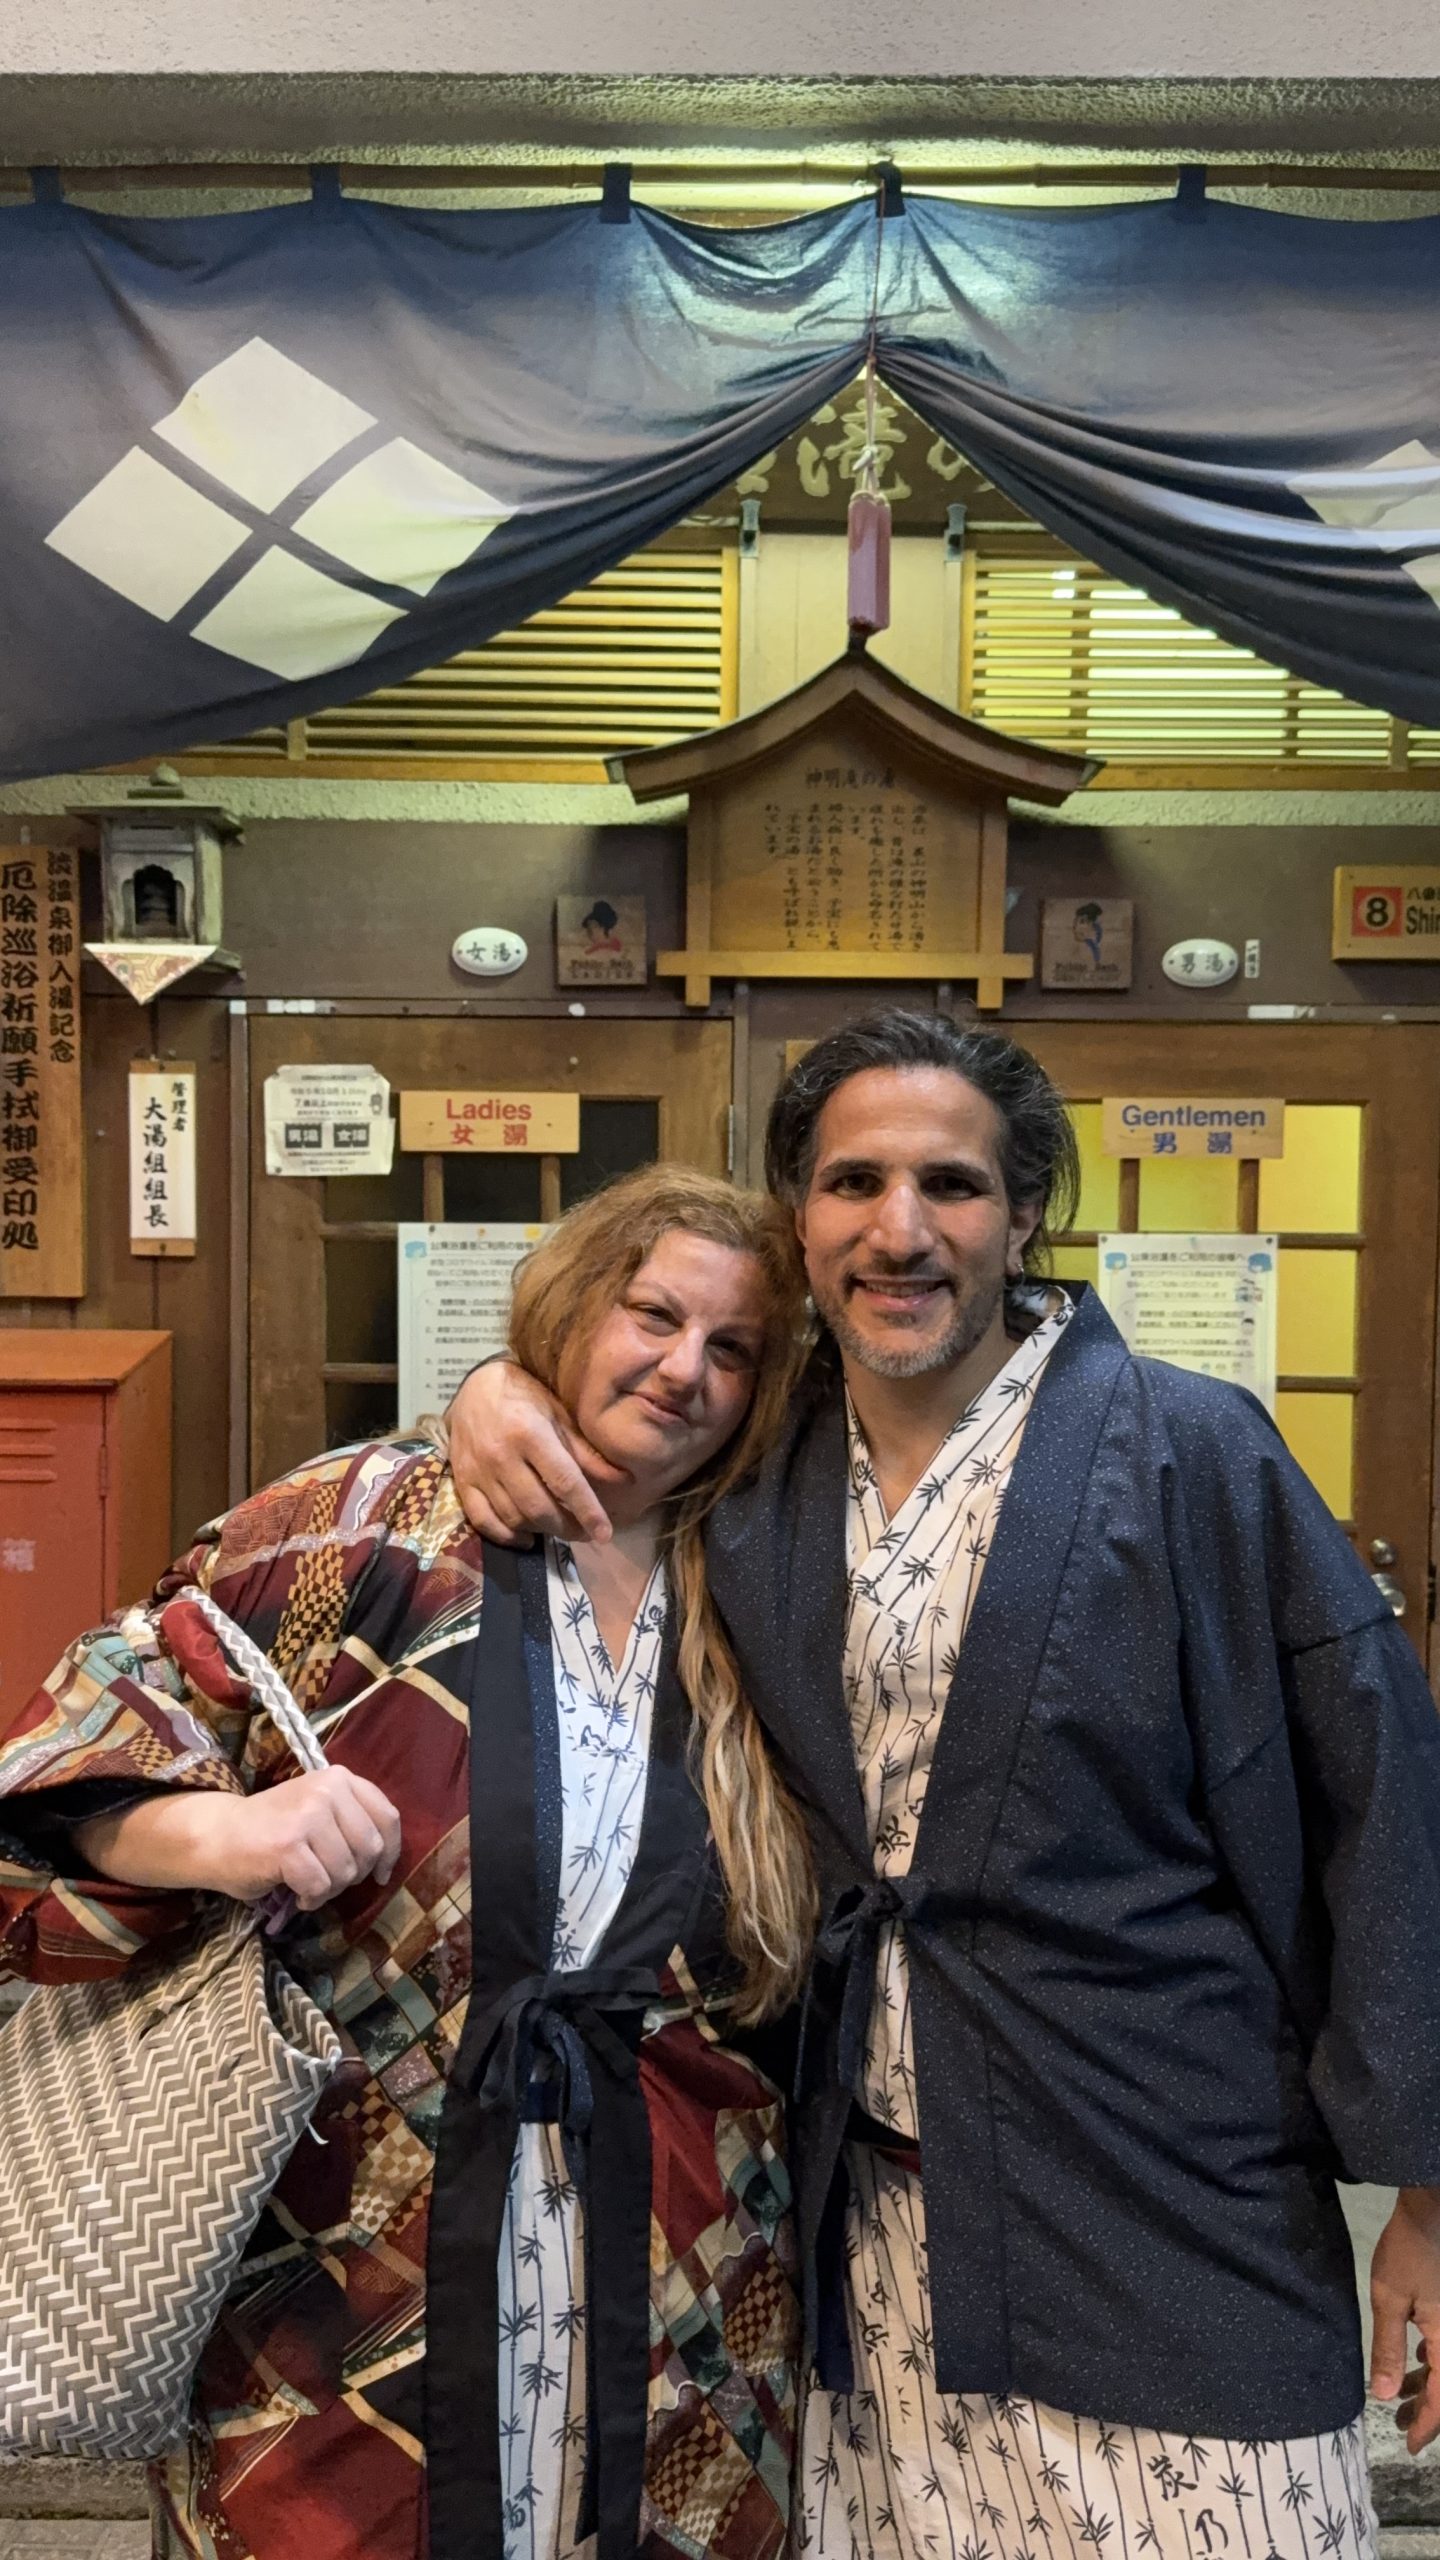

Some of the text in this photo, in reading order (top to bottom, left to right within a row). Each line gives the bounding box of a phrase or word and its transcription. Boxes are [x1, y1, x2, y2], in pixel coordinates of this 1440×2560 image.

[1366, 896, 1389, 927] 8
[466, 942, 512, 962] 女湯
[1181, 952, 1225, 974] 男湯
[1, 861, 40, 1251] 厄除巡浴祈願手拭御受印処
[170, 1081, 189, 1133] 管理者
[446, 1099, 532, 1121] Ladies
[1122, 1104, 1266, 1127] Gentlemen
[450, 1123, 528, 1147] 女湯
[1153, 1131, 1233, 1155] 男湯
[143, 1097, 169, 1228] 大湯組組長
